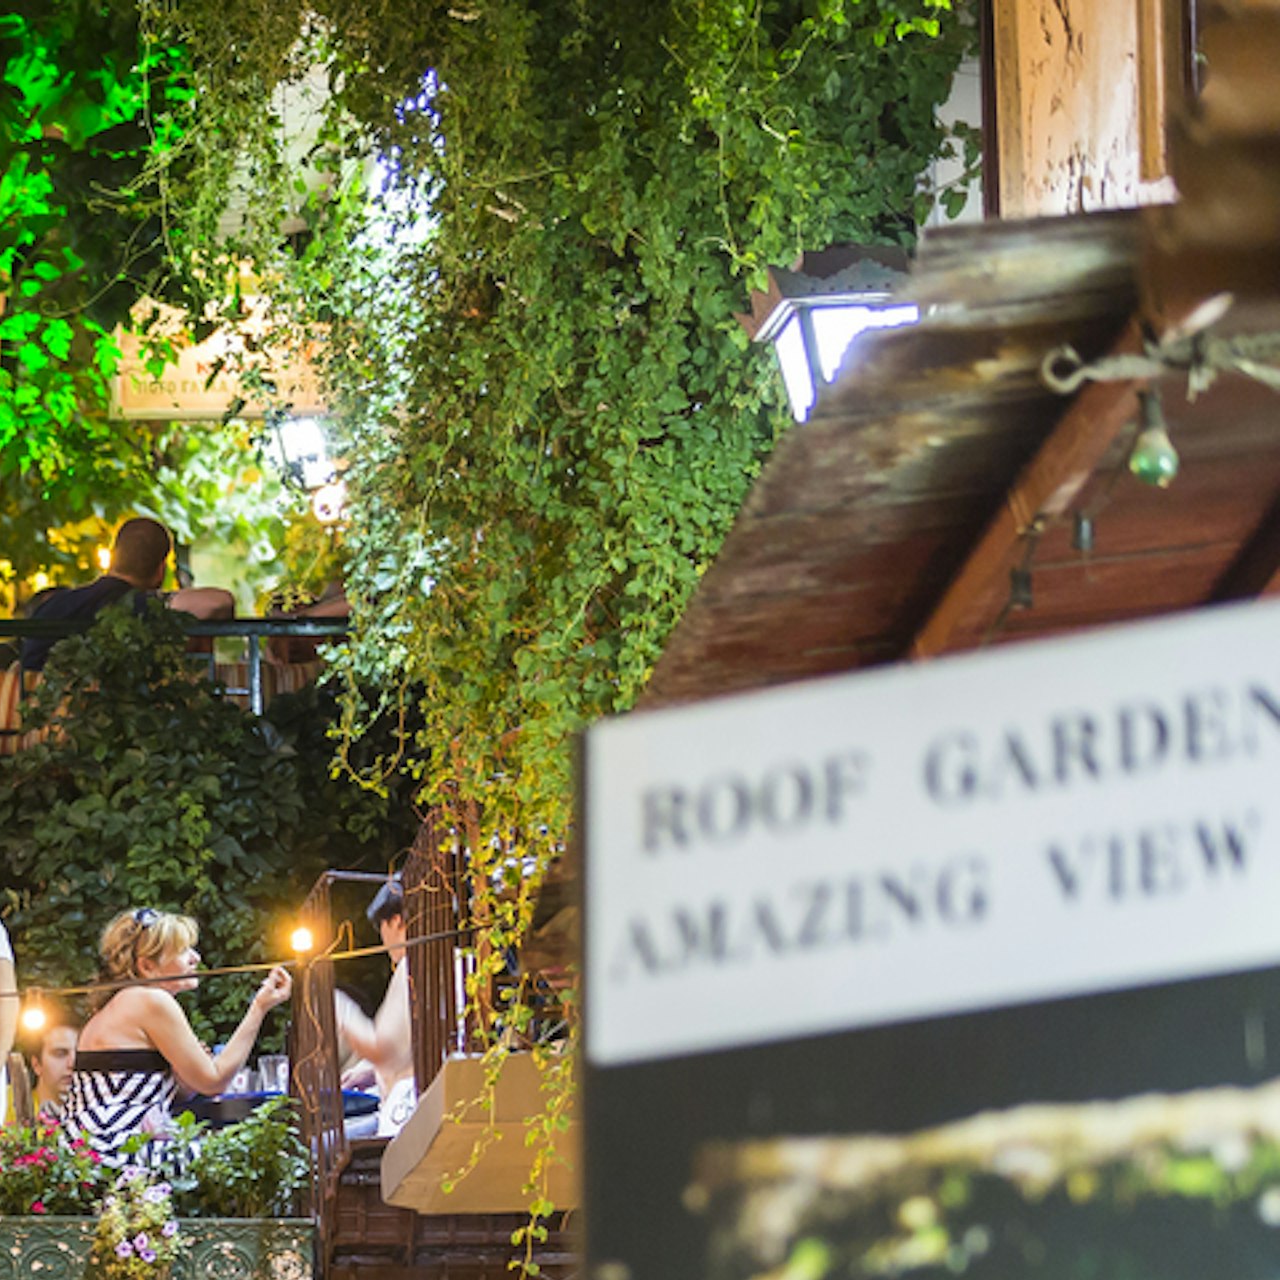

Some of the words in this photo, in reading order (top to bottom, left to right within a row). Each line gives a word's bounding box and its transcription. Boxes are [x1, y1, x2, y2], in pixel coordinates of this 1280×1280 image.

[640, 750, 872, 856] ROOF
[608, 855, 988, 980] AMAZING
[1046, 805, 1260, 901] VIEW
